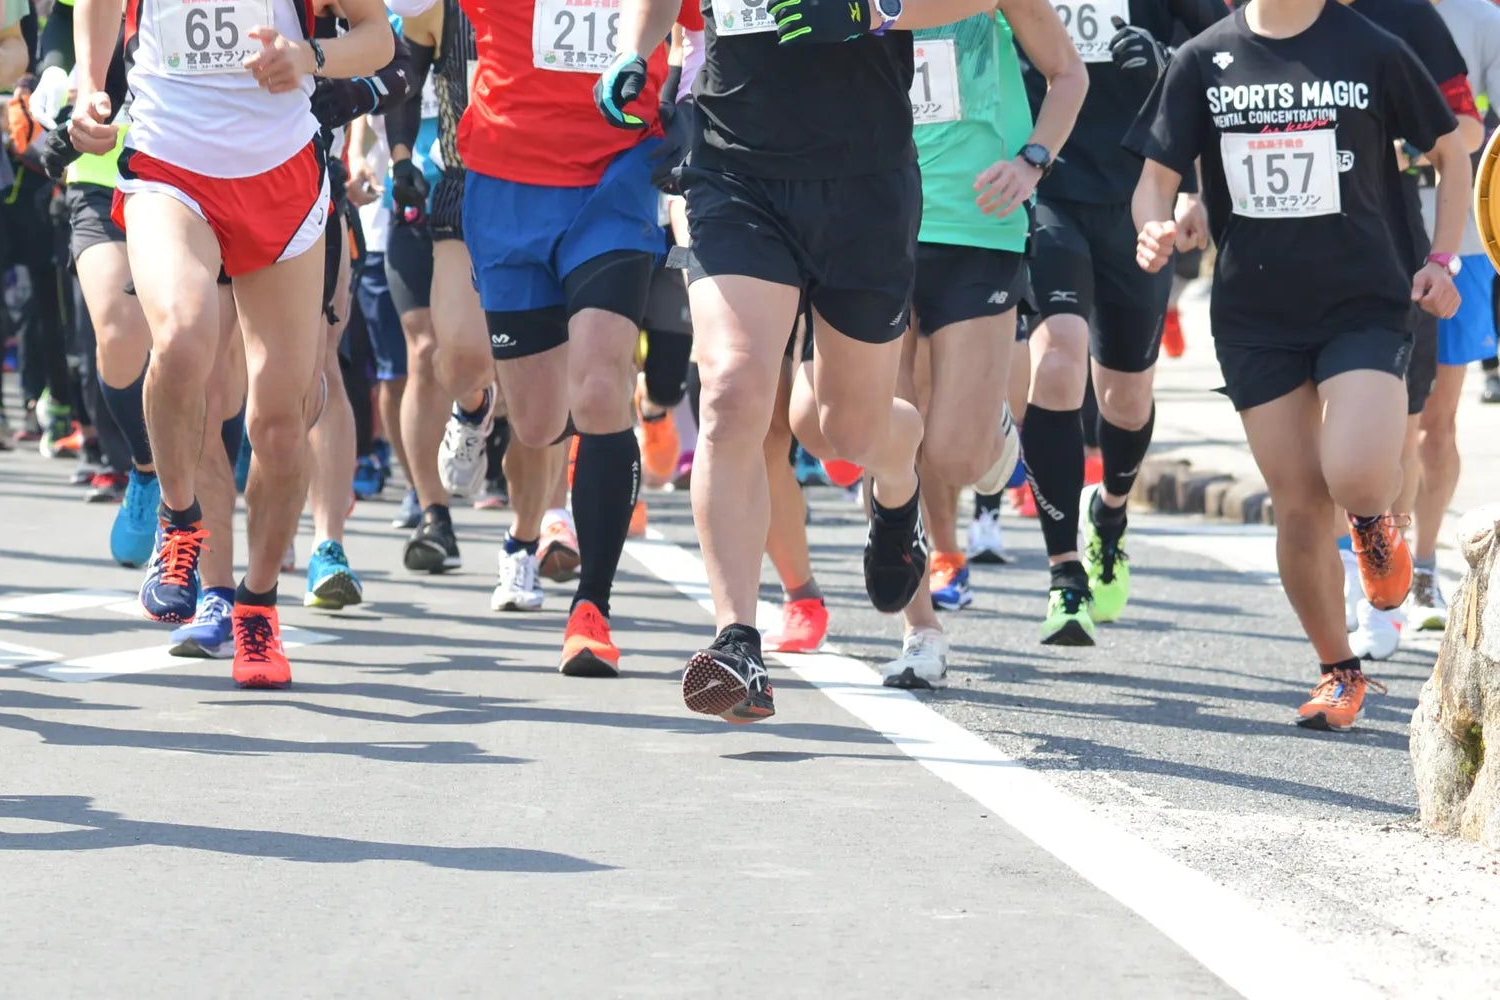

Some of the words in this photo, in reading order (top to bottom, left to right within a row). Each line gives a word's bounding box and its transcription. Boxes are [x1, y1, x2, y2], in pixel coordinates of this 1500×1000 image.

[185, 6, 239, 51] 65
[563, 51, 613, 64] 宮島マラ
[1206, 82, 1294, 114] SPORTS
[1301, 80, 1369, 109] MAGIC
[1213, 112, 1246, 128] MENTAL
[1248, 108, 1337, 124] CONCENTRATION
[1241, 152, 1315, 195] 157
